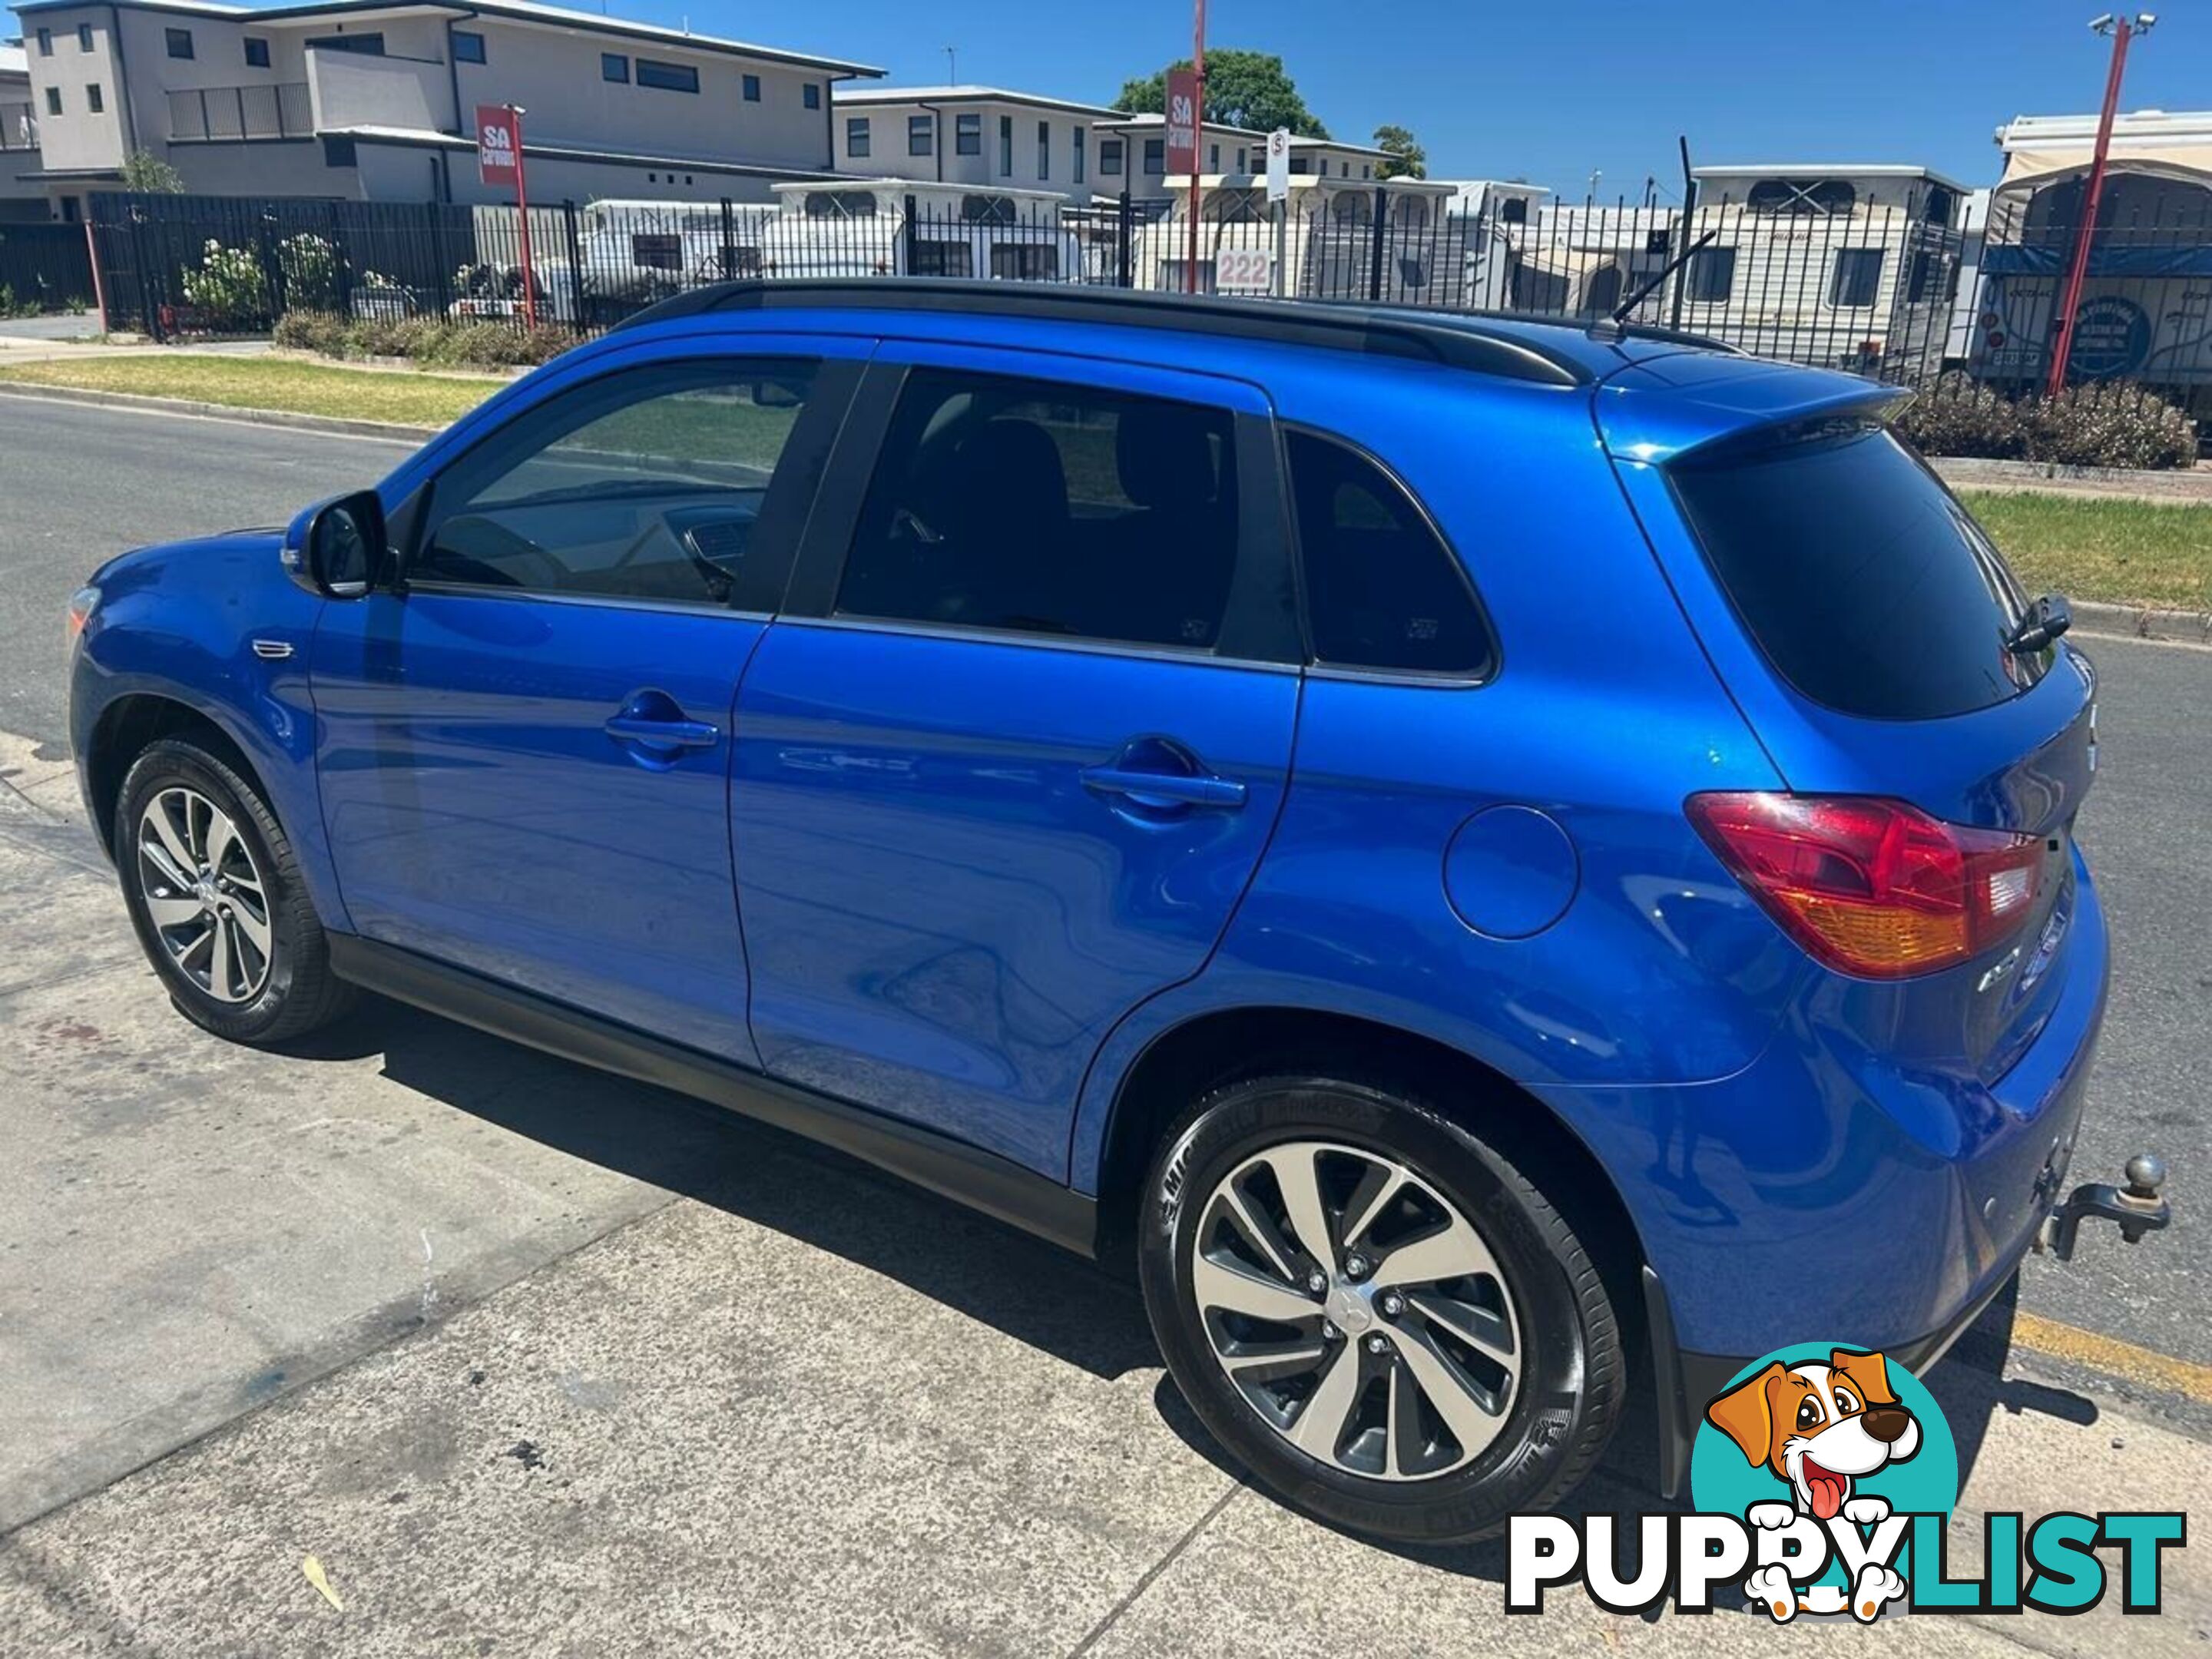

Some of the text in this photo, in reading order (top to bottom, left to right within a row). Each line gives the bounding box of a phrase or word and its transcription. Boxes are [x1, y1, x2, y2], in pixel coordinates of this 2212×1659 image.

[1172, 94, 1192, 124] SA
[483, 125, 511, 148] SA
[1220, 254, 1267, 283] 222
